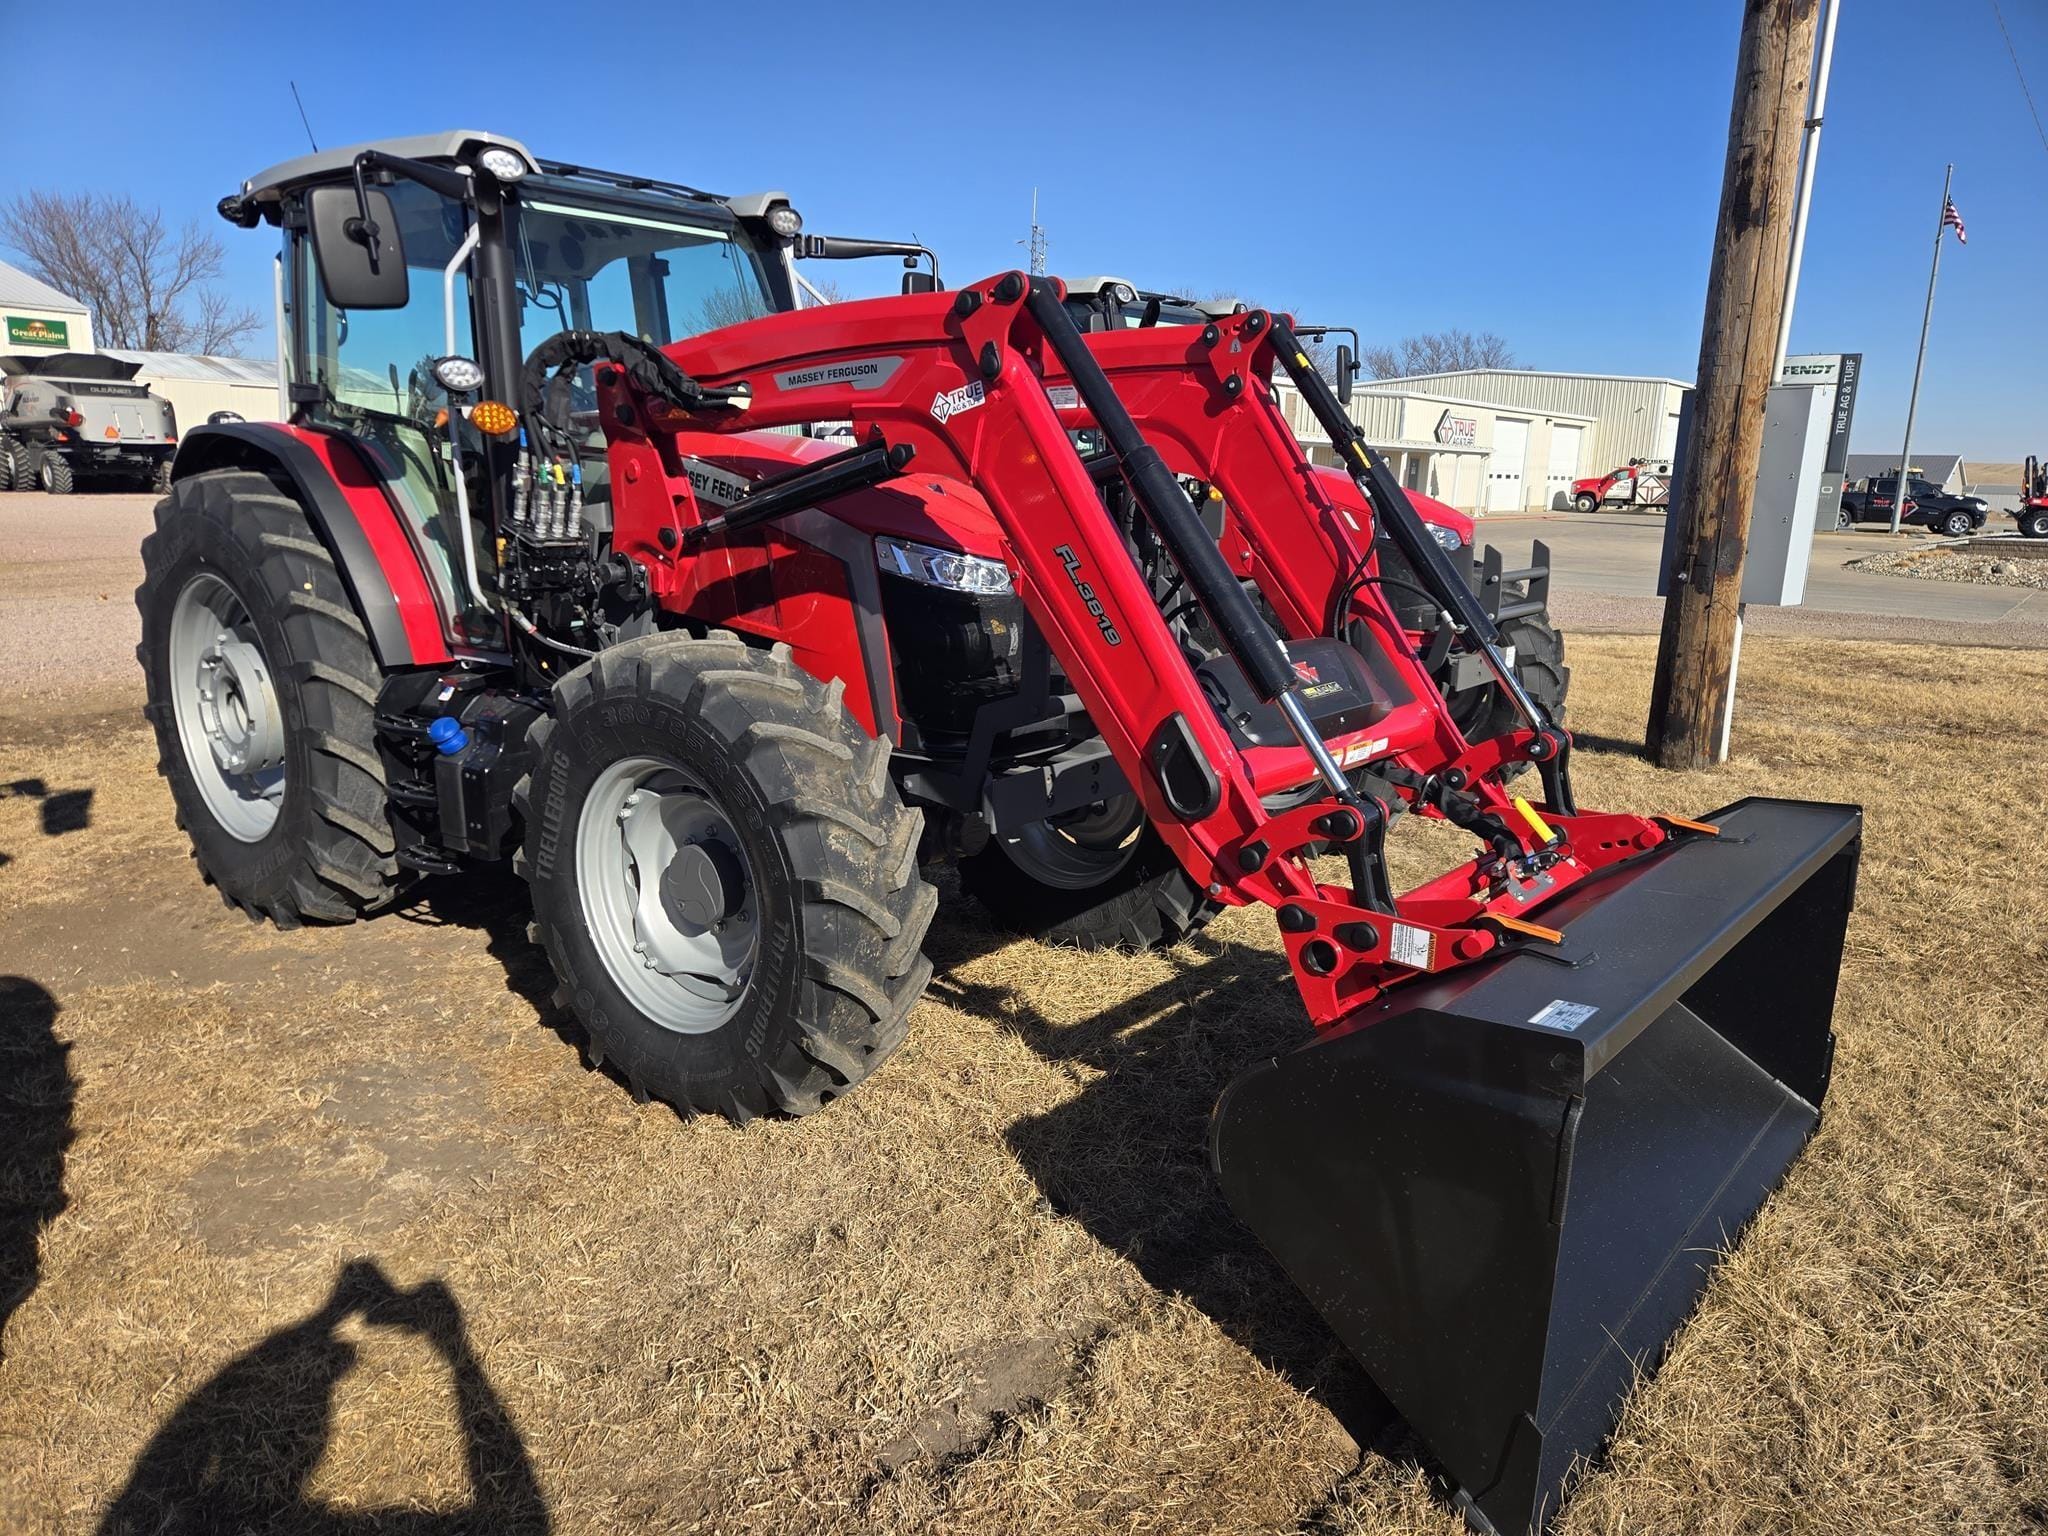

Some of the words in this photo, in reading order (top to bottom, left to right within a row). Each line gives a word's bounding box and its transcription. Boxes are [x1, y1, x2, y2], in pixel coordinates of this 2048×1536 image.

[12, 328, 38, 337] Great
[39, 329, 65, 340] Plains
[788, 371, 825, 386] MASSEY
[827, 363, 878, 379] FERGUSON
[1783, 364, 1835, 375] FENDT
[1843, 359, 1856, 384] TURF
[950, 382, 983, 404] TRUE
[1842, 385, 1852, 394] &
[1839, 395, 1851, 409] AG
[1454, 420, 1476, 437] TRUE
[1835, 410, 1848, 435] TRUE
[688, 470, 710, 491] SEY
[711, 478, 744, 502] FERG
[535, 749, 571, 881] TRELLEBORG
[743, 917, 791, 1060] TRELLEBORG
